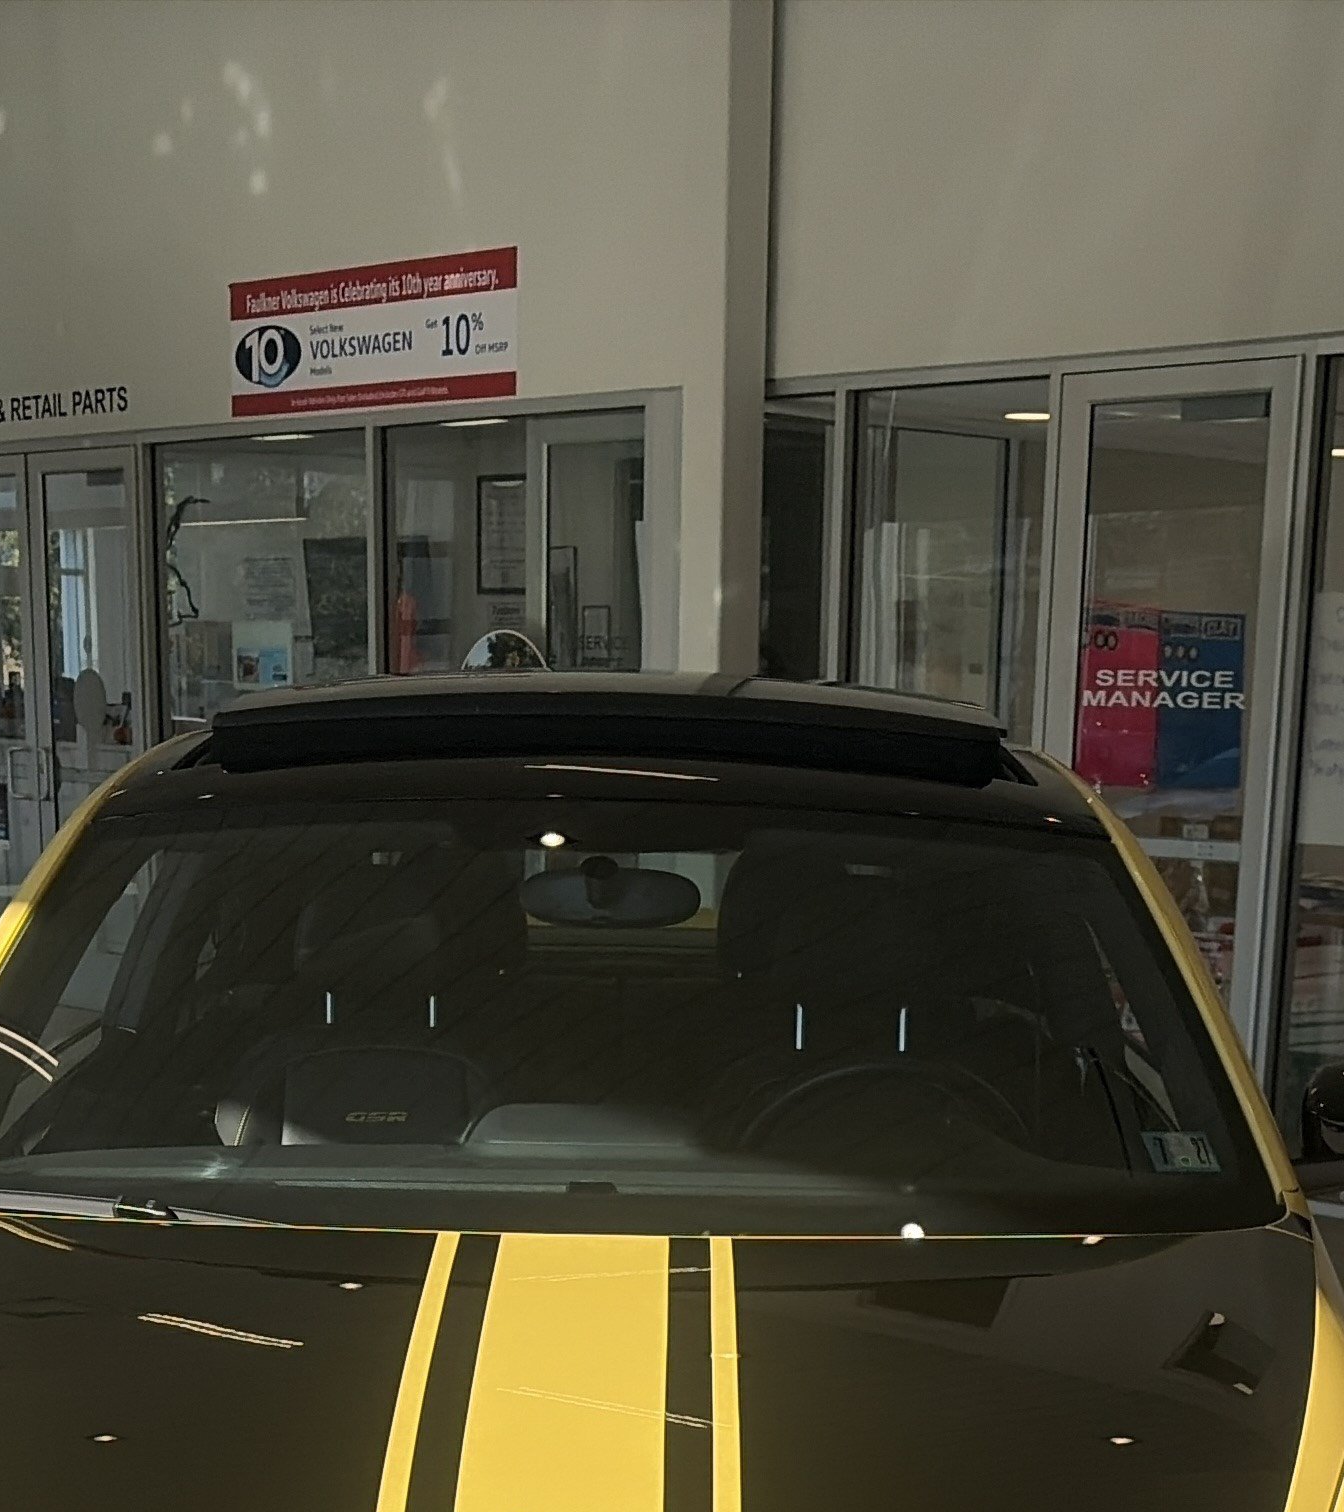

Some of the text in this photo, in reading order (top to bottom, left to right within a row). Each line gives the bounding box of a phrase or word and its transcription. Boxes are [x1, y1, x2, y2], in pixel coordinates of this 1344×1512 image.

[245, 328, 285, 382] 10
[309, 330, 413, 360] VOLKSWAGEN
[10, 392, 68, 422] RETAIL
[72, 386, 129, 417] PARTS
[1095, 668, 1235, 689] SERVICE
[1081, 689, 1246, 710] MANAGER
[345, 1110, 408, 1123] GSR
